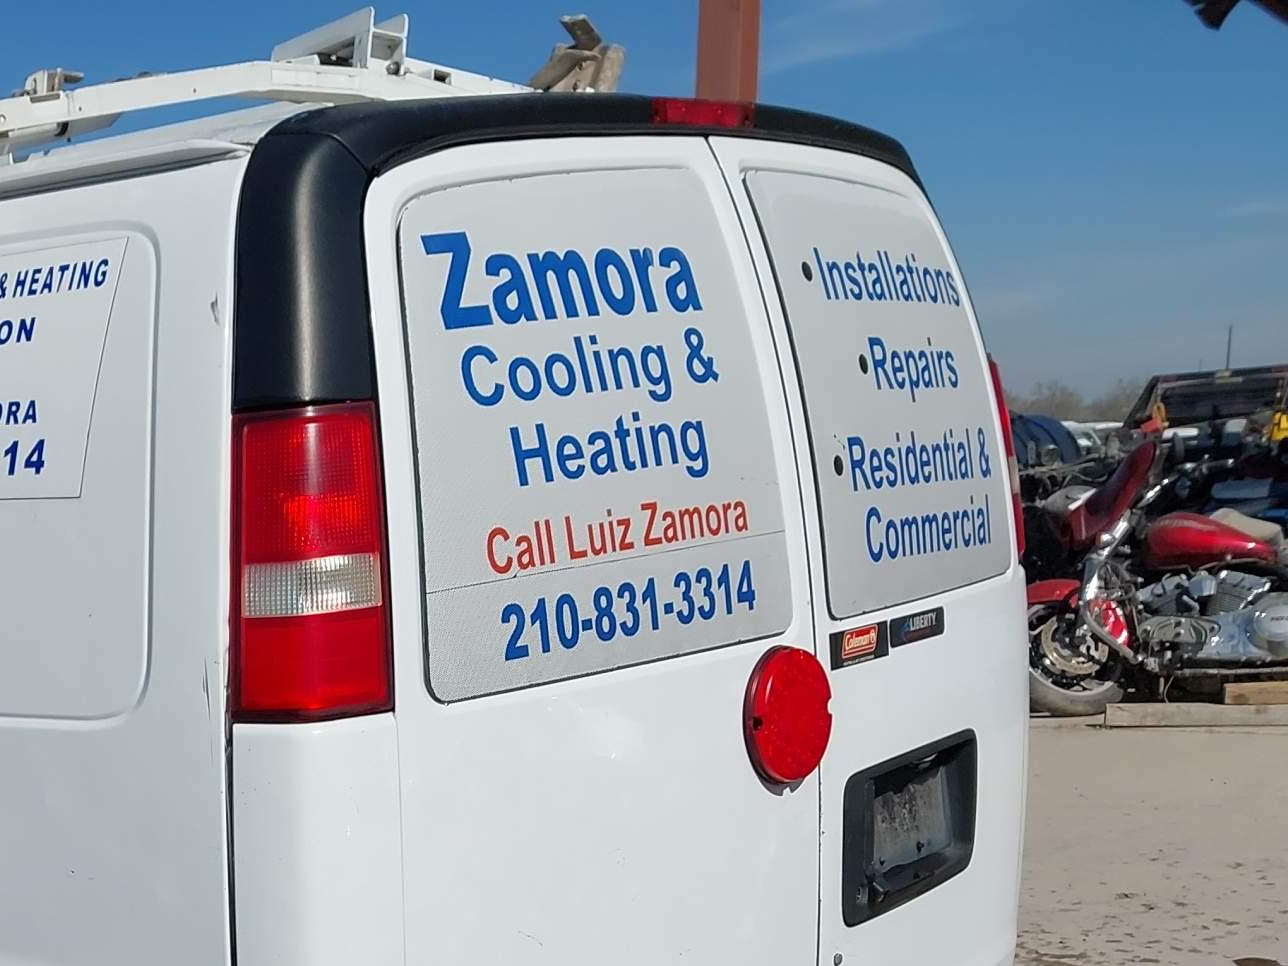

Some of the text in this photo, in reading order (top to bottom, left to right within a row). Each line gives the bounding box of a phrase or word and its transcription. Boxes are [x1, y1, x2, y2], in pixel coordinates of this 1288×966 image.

[421, 231, 703, 330] Zamora
[461, 327, 719, 406] Cooling &
[868, 336, 958, 403] Repairs
[510, 411, 709, 487] Heating
[847, 427, 991, 491] Residential &
[486, 500, 749, 574] Call Luiz Zamora
[865, 494, 991, 562] Commercial
[500, 560, 756, 661] 210-831-3314
